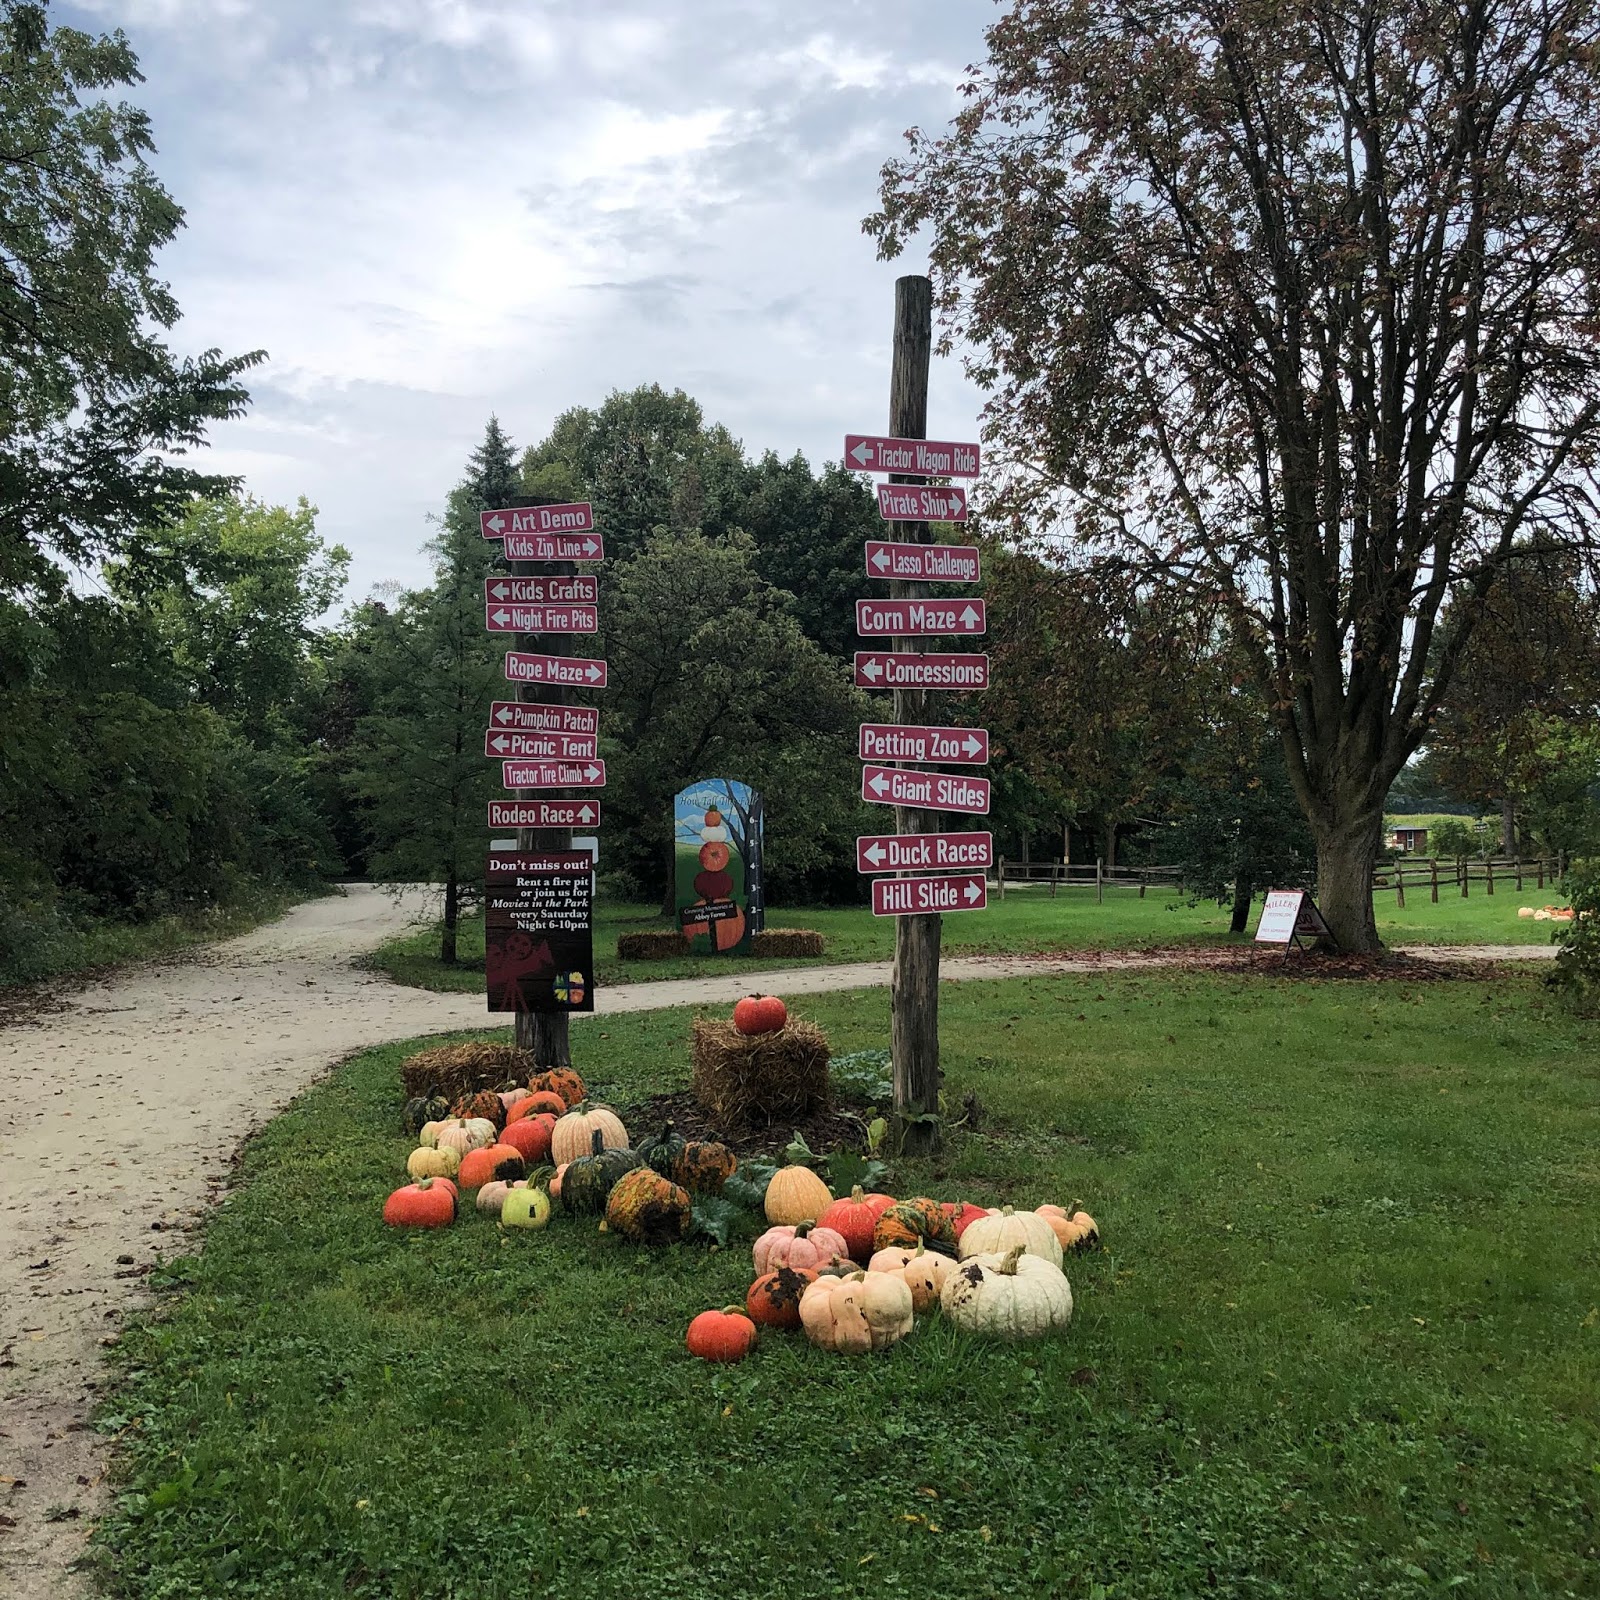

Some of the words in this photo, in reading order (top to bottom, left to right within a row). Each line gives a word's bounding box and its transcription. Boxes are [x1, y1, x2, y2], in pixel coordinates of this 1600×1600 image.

[877, 443, 913, 469] Tractor
[916, 445, 950, 474] Wagon
[954, 448, 975, 472] Ride
[880, 490, 918, 515] Pirate
[920, 491, 948, 519] Ship
[512, 513, 536, 531] Art
[541, 510, 585, 529] Demo
[508, 537, 534, 556] Kids
[536, 538, 554, 559] Zip
[558, 538, 580, 556] Line
[892, 549, 921, 574] Lasso
[924, 551, 976, 580] Challenge
[511, 581, 544, 600] Kids
[549, 580, 593, 599] Crafts
[512, 609, 542, 630] Night
[546, 610, 568, 628] Fire
[572, 610, 593, 628] Pits
[861, 606, 903, 630] Corn
[909, 605, 956, 630] Maze
[509, 657, 542, 679] Rope
[547, 661, 583, 681] Maze
[885, 658, 984, 683] Concessions
[514, 708, 560, 730] Pumpkin
[563, 711, 593, 731] Patch
[511, 735, 556, 755] Picnic
[561, 738, 592, 757] Tent
[864, 730, 925, 760] Petting
[931, 733, 959, 757] Zoo
[507, 765, 538, 784] Tractor
[539, 765, 556, 783] Tire
[558, 764, 582, 783] Climb
[892, 774, 931, 801] Giant
[937, 779, 985, 807] Slides
[492, 805, 535, 824] Rodeo
[540, 805, 574, 823] Race
[888, 839, 931, 866] Duck
[937, 839, 987, 863] Races
[490, 860, 526, 871] Don't
[529, 860, 560, 870] miss
[563, 859, 589, 870] out!
[516, 878, 541, 886] Rent
[553, 877, 571, 886] fire
[574, 878, 588, 889] pit
[751, 884, 756, 892] 3
[491, 899, 532, 908] Movies
[532, 899, 542, 907] in
[546, 899, 561, 907] the
[564, 898, 588, 907] Park
[534, 888, 555, 901] join
[573, 887, 588, 896] for
[882, 883, 913, 910] Hill
[918, 881, 958, 907] Slide
[541, 909, 588, 920] Saturday
[751, 906, 756, 914] 2
[517, 920, 546, 931] Night
[549, 920, 588, 931] 6-10pm
